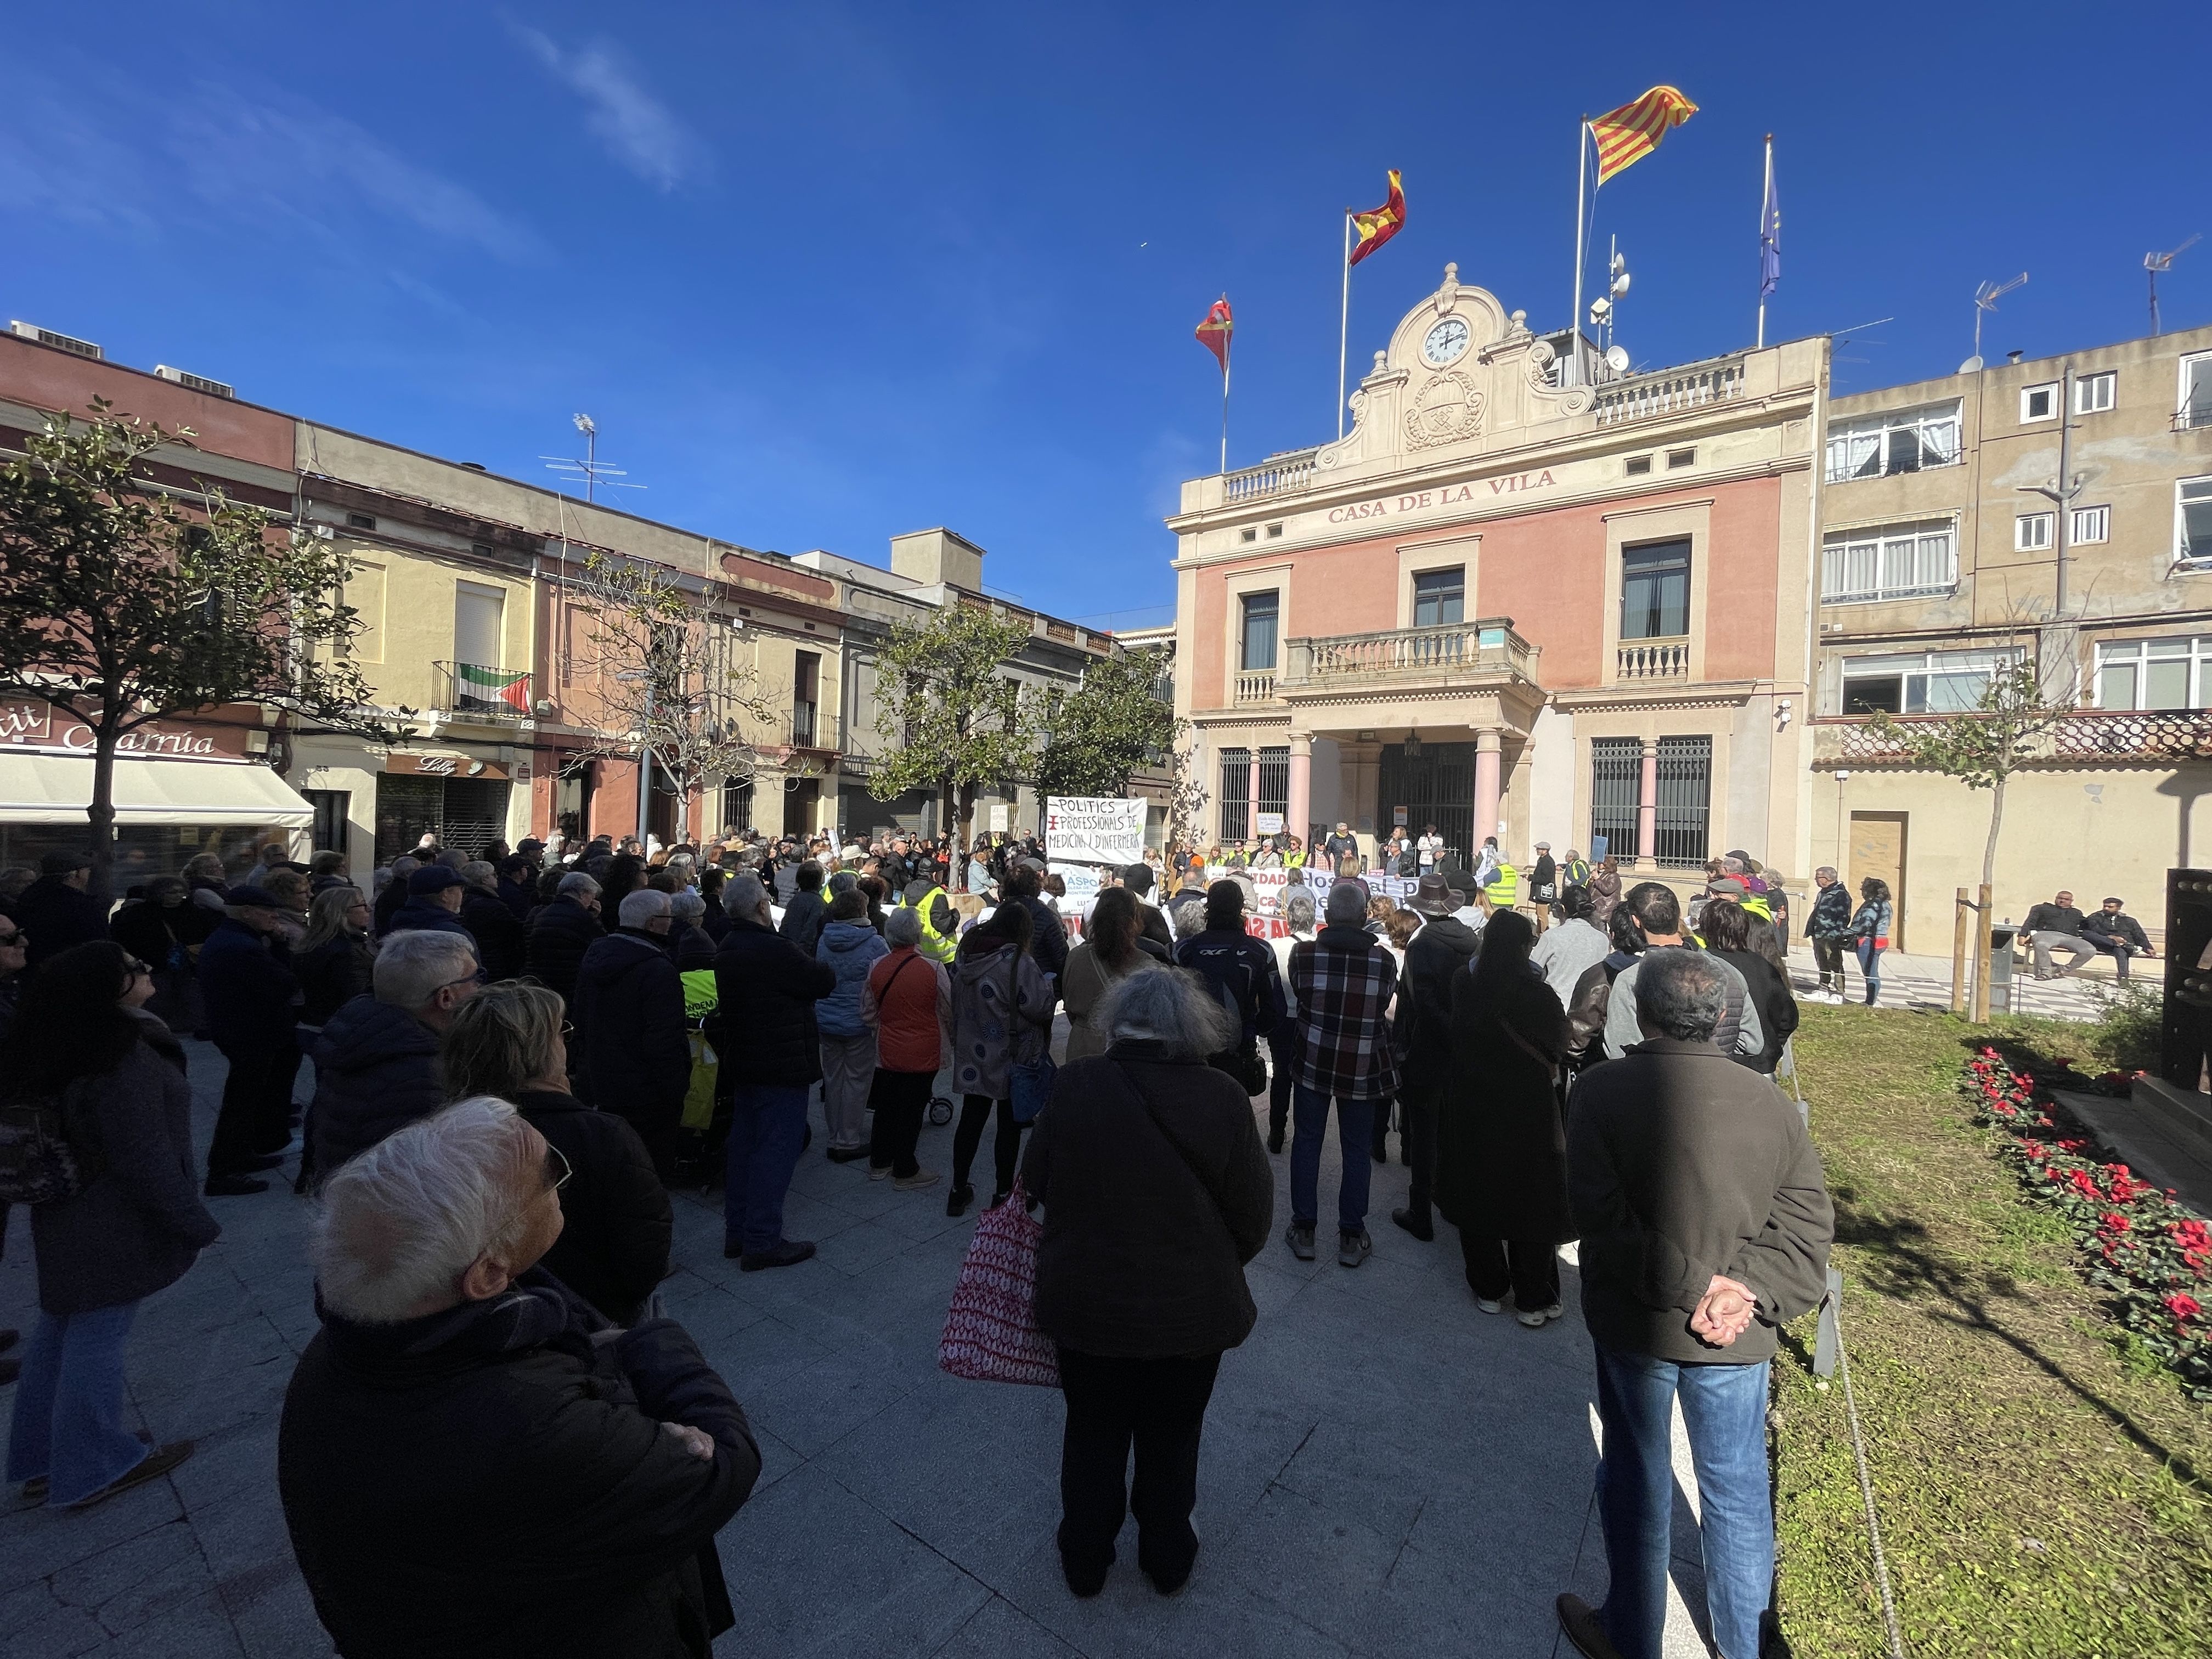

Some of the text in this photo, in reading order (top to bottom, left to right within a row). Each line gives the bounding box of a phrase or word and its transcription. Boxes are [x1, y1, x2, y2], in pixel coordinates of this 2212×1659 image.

[1328, 470, 1556, 523] CASA DE LA VILA
[63, 725, 215, 753] Carrúa
[415, 757, 456, 776] Lilly
[1059, 815, 1137, 830] PROFESSIONALS DE
[1049, 833, 1086, 848] MEDICINA
[1250, 873, 1286, 885] IDAD
